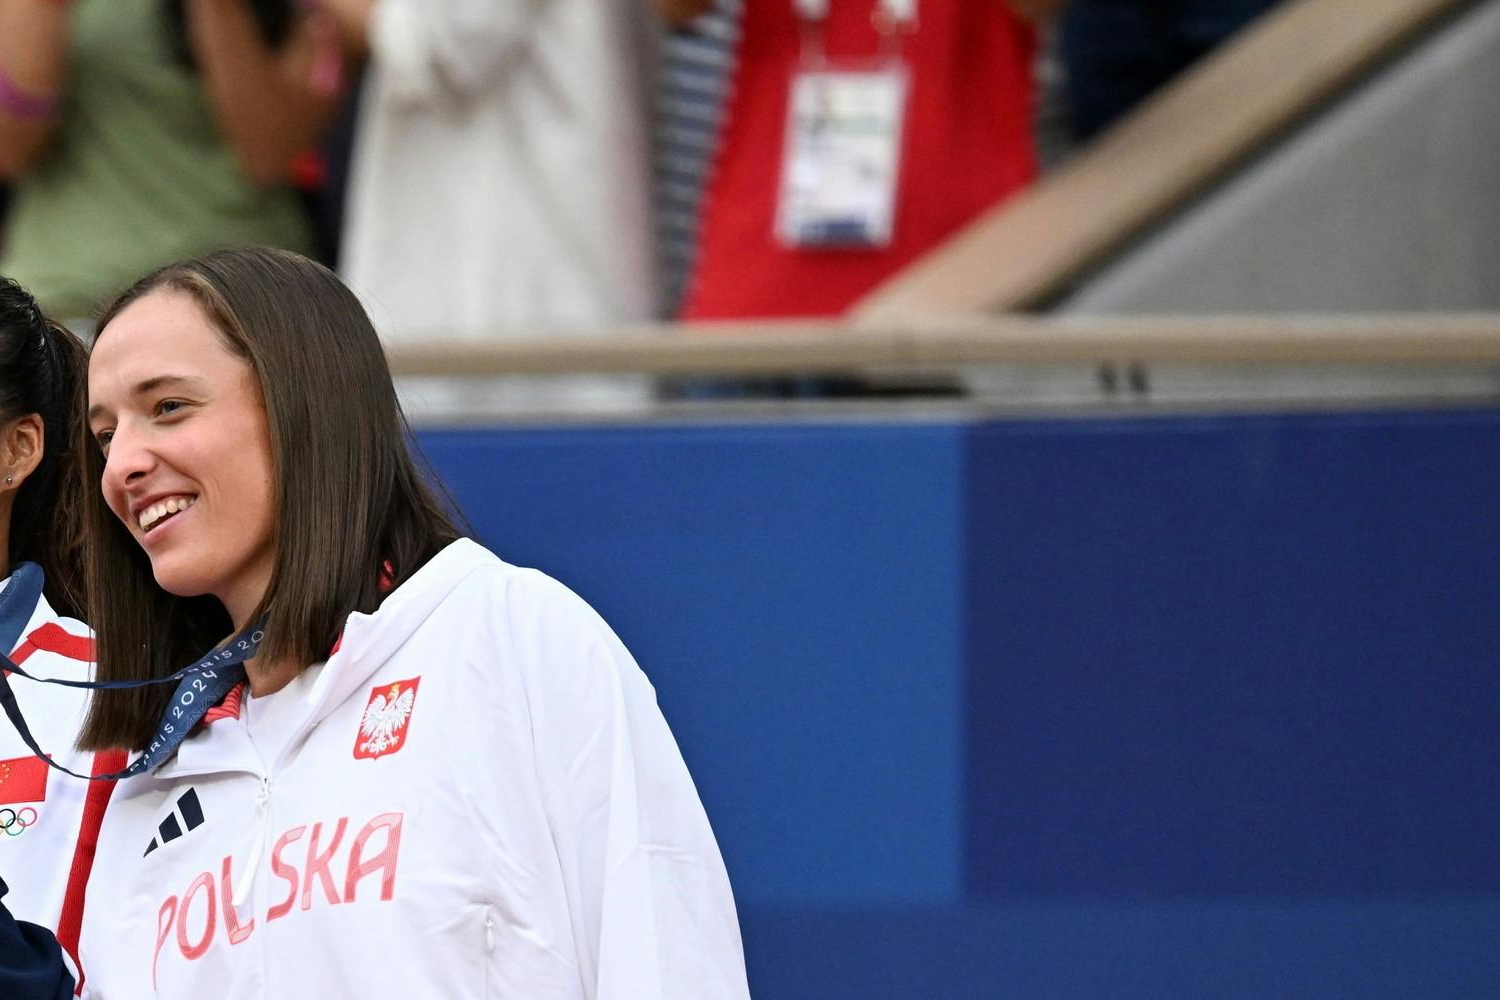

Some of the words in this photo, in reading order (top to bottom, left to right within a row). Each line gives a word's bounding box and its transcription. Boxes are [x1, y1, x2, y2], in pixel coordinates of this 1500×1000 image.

[238, 630, 265, 650] 20
[172, 670, 218, 720] 2024
[152, 812, 404, 992] POLSKA
